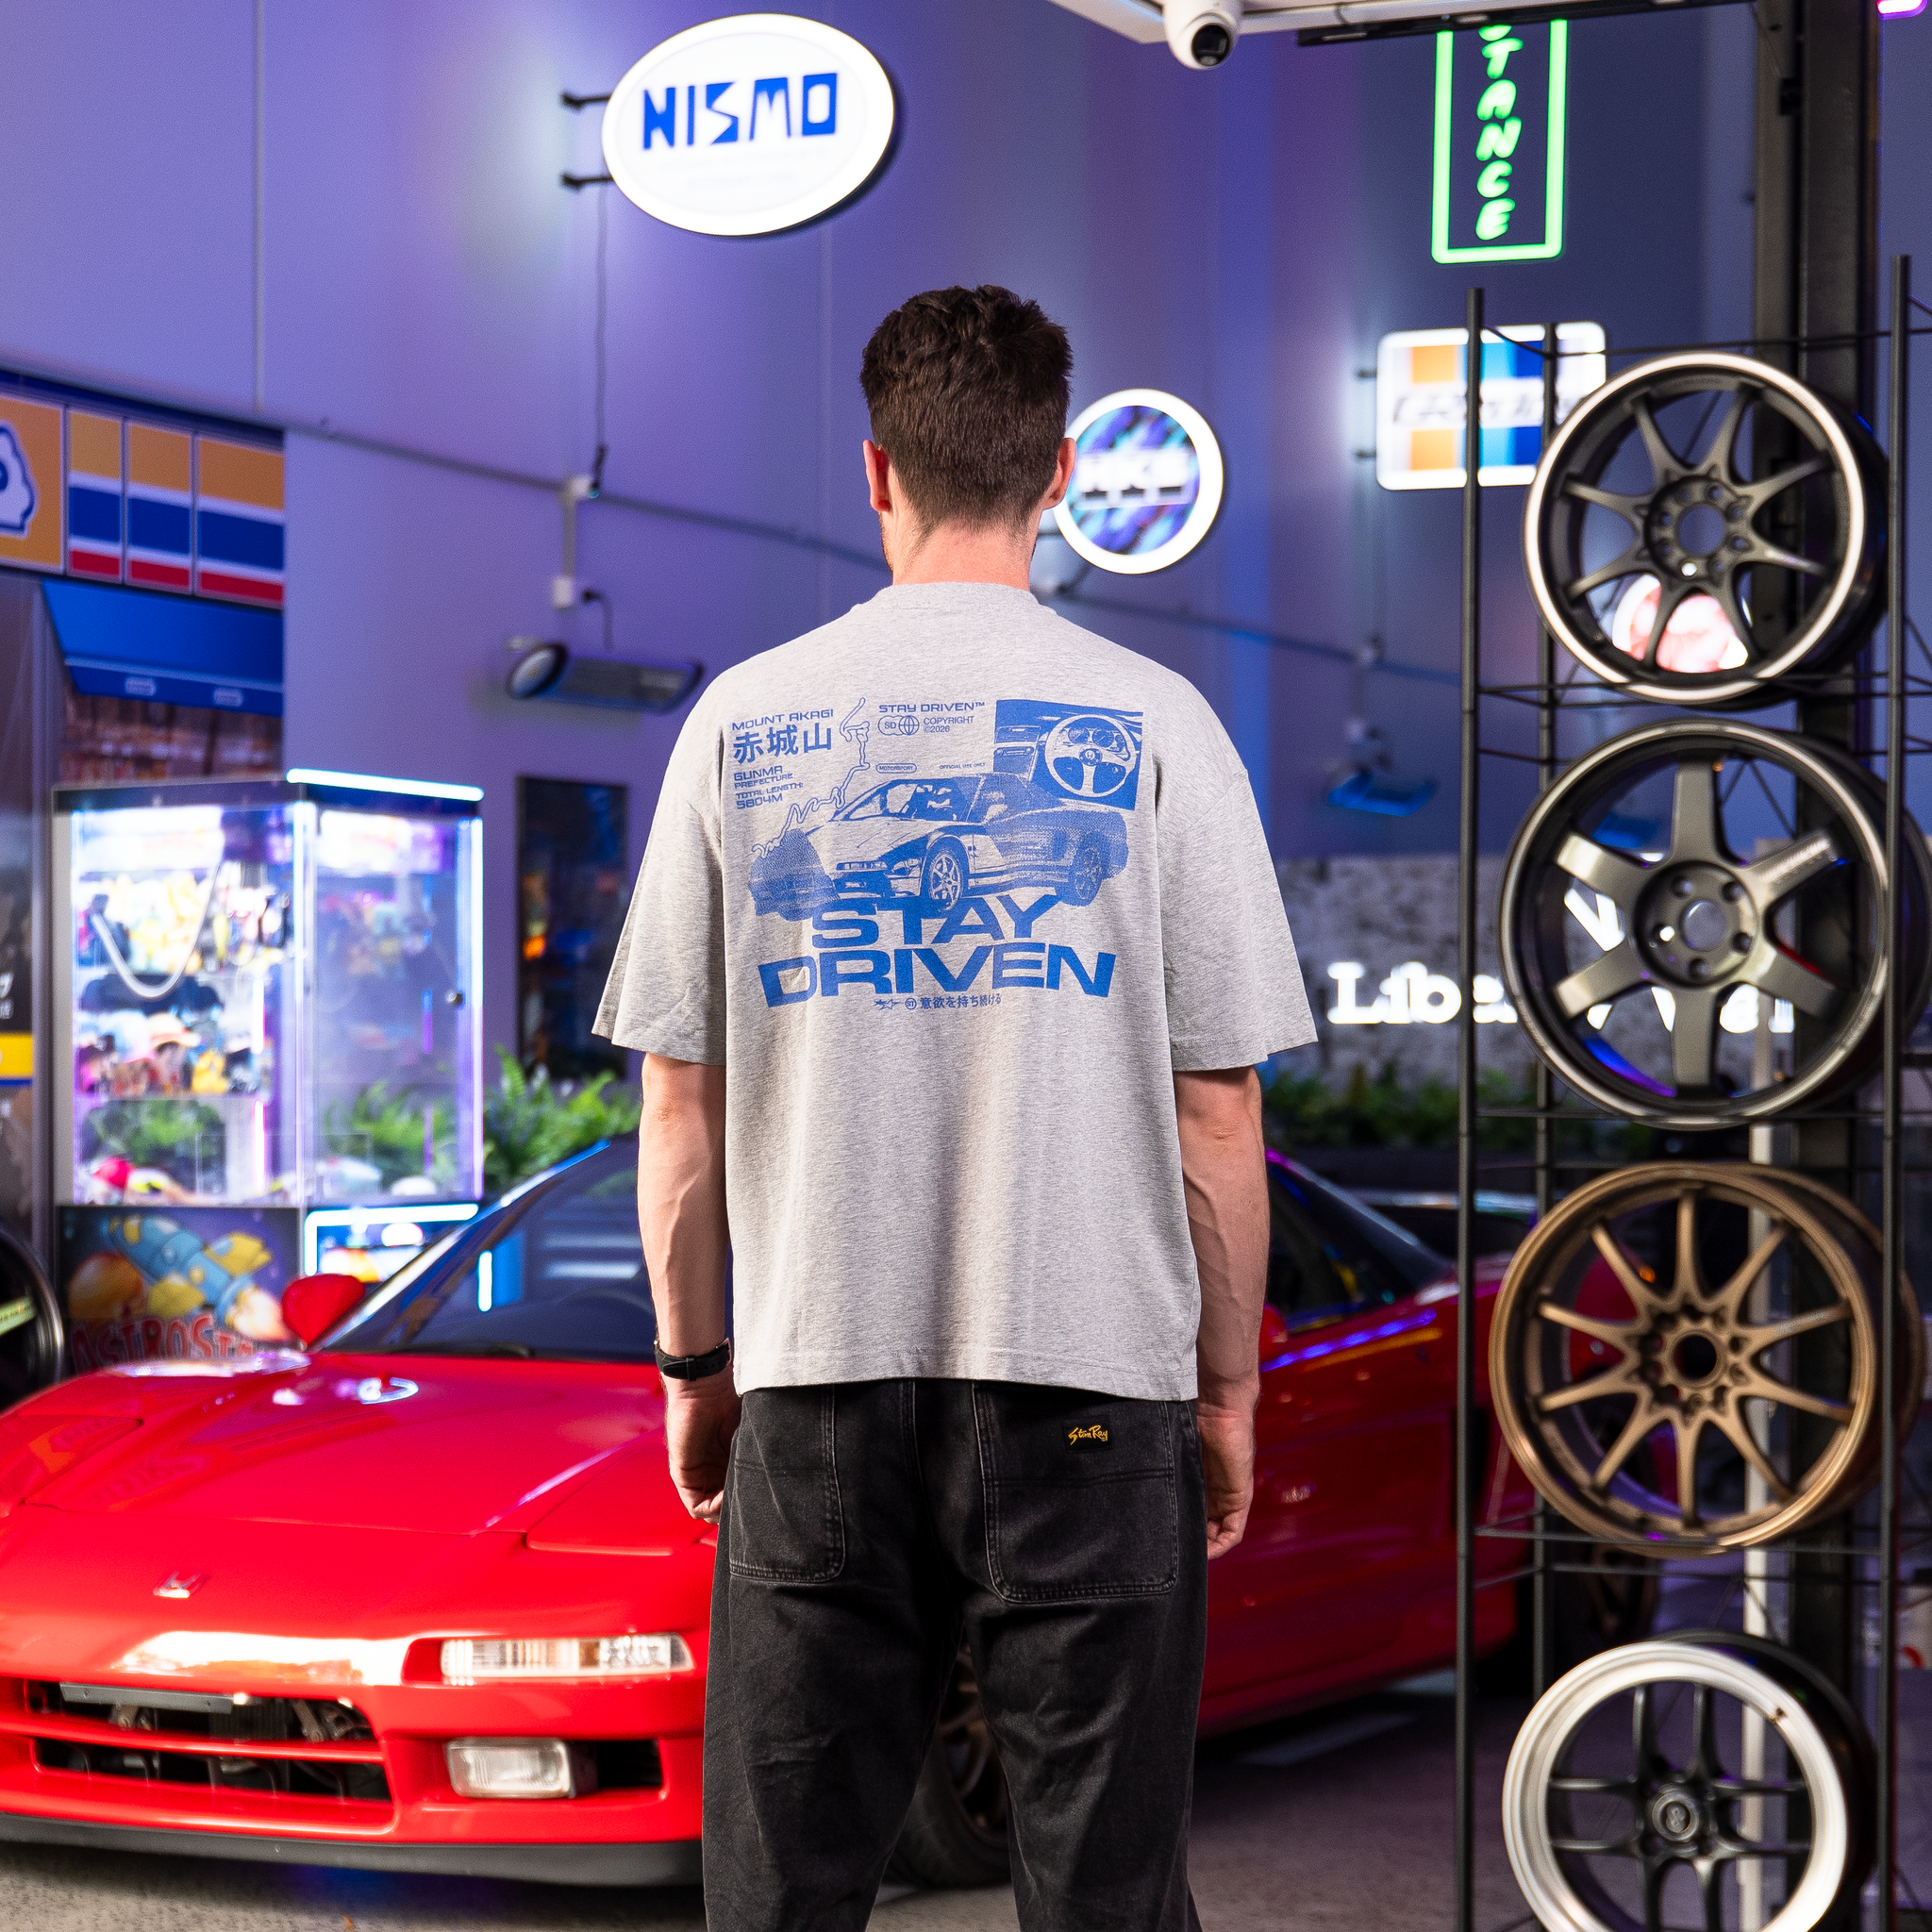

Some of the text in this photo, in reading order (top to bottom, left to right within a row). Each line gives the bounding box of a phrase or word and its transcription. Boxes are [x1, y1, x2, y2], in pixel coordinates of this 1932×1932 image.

[642, 73, 838, 151] NISMO
[879, 704, 917, 713] STAY
[732, 708, 834, 730] MOUNT AKAGI
[884, 722, 897, 730] SD
[923, 715, 975, 725] COPYRIGHT
[732, 722, 832, 764] 赤城山
[734, 765, 784, 782] GUNMA
[734, 773, 794, 790] PREFECTURE
[735, 781, 804, 800] TOTAL LENGTH:
[811, 894, 1060, 949] STAY
[758, 942, 1117, 1008] DRIVEN
[1068, 1424, 1108, 1445] Stan Ray
